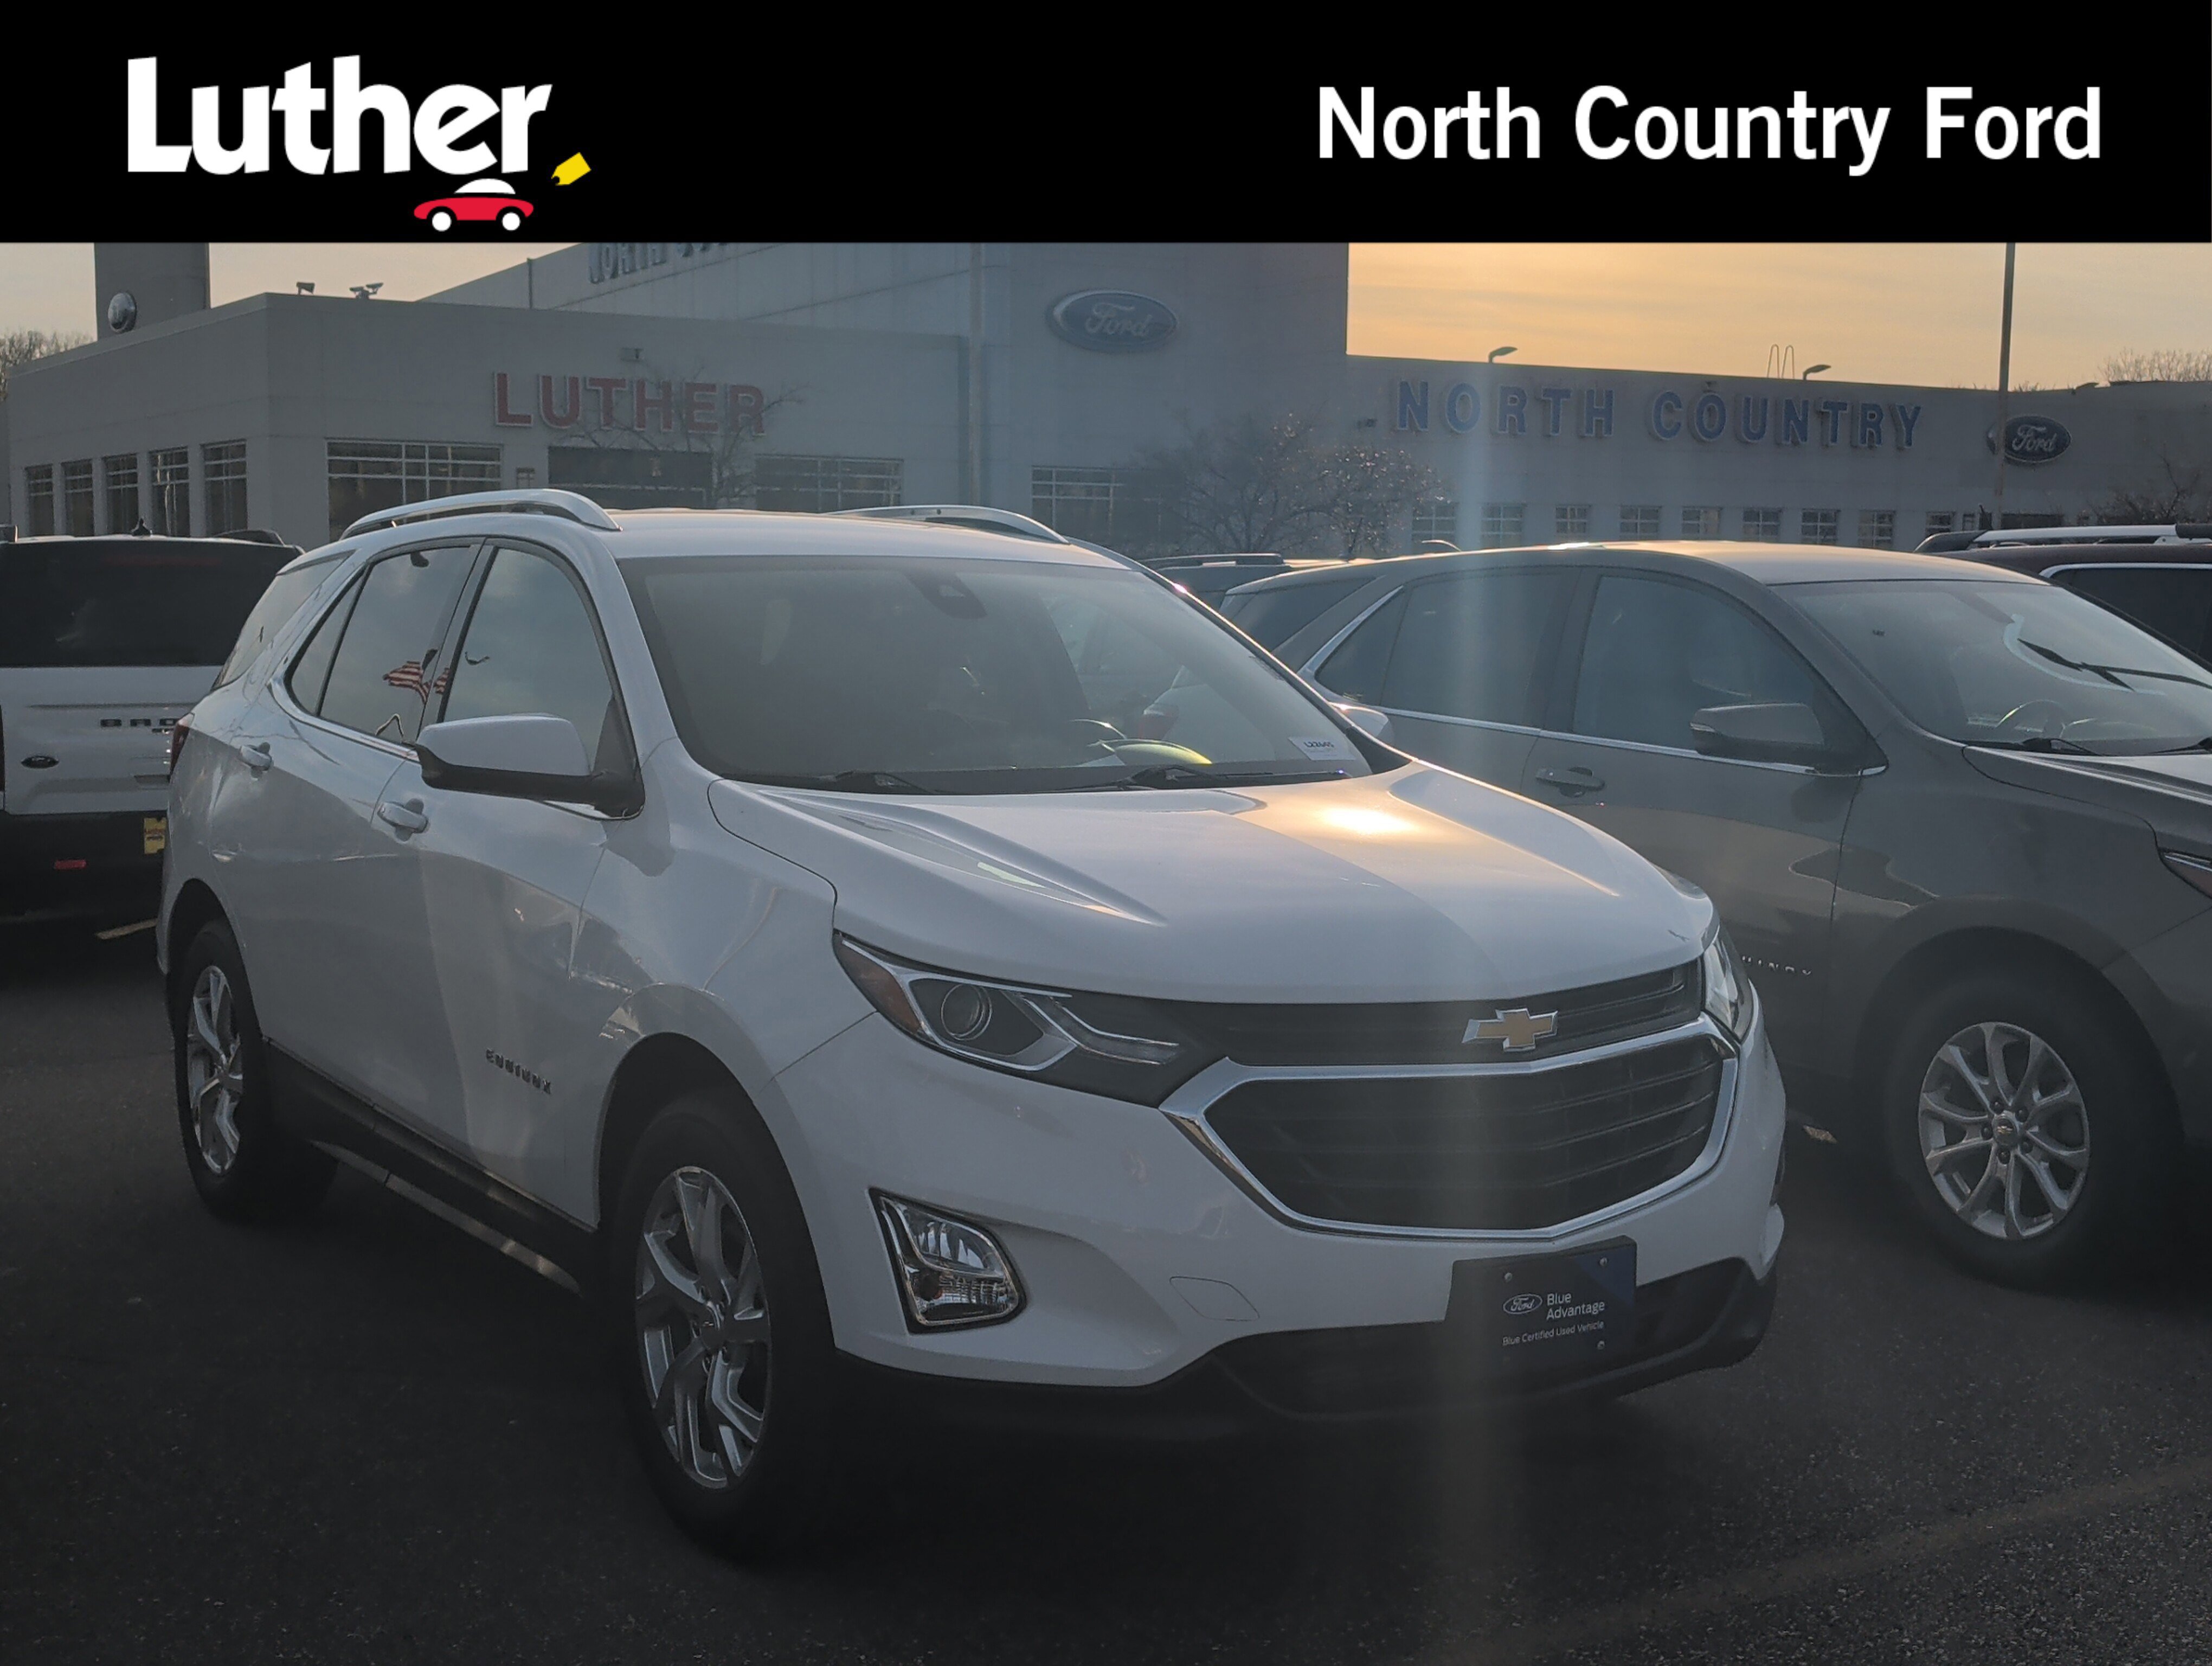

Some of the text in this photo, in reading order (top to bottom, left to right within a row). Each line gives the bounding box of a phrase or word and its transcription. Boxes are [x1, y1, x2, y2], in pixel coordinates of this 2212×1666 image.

[1085, 302, 1153, 337] Ford
[494, 372, 766, 435] LUTHER
[1397, 380, 1922, 450] NORTH COUNTRY
[2012, 424, 2057, 452] Ford
[1510, 1297, 1535, 1312] Ford
[1546, 1301, 1605, 1321] Advantage
[1547, 1292, 1572, 1306] Blue
[1502, 1336, 1520, 1346] Blue
[1522, 1328, 1554, 1342] Certified
[1556, 1324, 1576, 1336] Used
